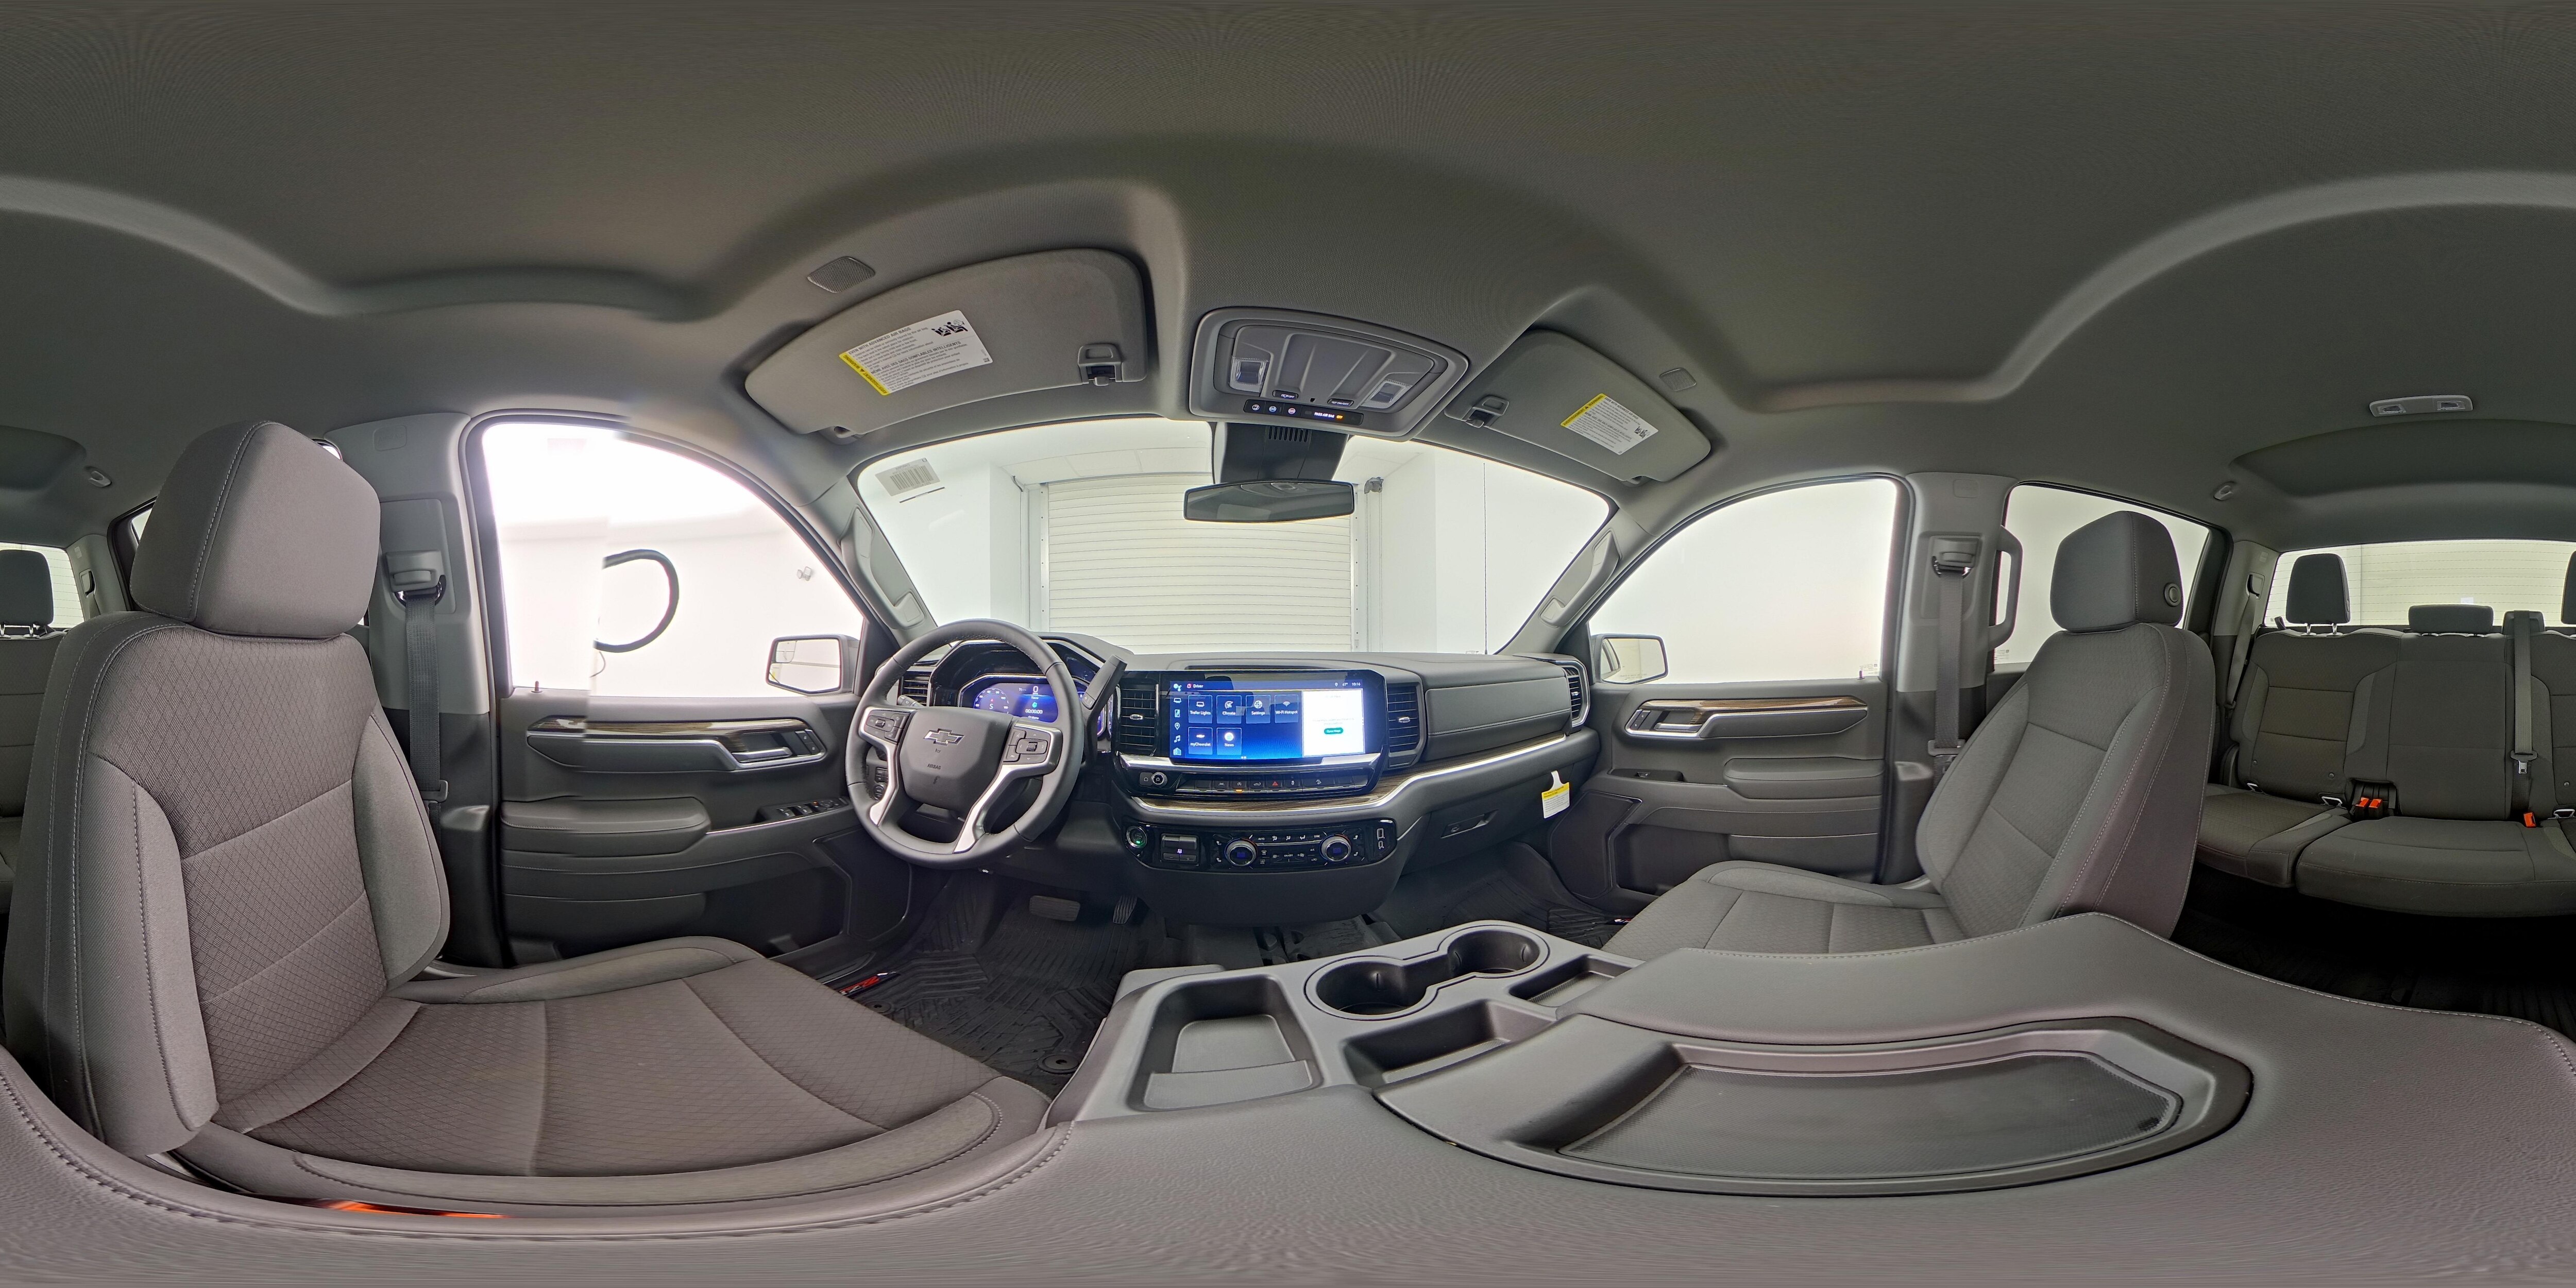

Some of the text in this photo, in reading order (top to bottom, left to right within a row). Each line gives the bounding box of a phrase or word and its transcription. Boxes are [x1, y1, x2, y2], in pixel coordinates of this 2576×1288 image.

[869, 335, 890, 346] ADVANCED
[908, 349, 933, 360] GONFLABLES
[933, 341, 961, 351] INTELLIGENTS
[843, 355, 860, 369] WARNING
